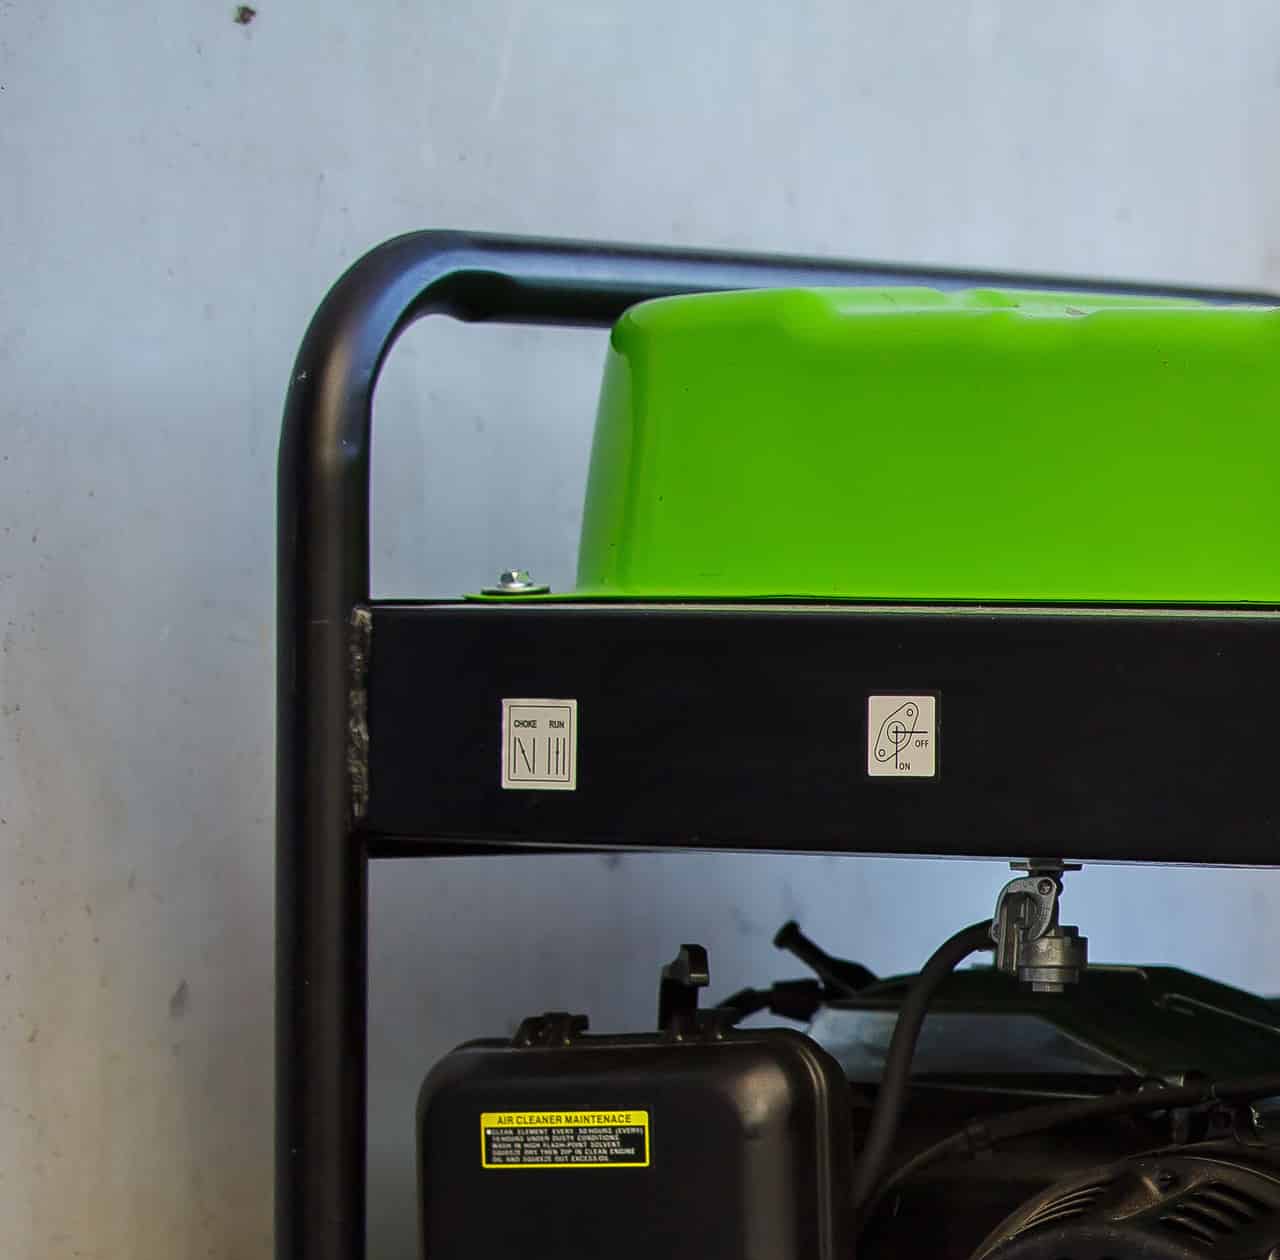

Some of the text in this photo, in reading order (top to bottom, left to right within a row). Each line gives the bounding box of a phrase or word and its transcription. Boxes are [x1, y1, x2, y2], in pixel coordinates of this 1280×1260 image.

[513, 719, 565, 728] CHOKE RUN
[915, 739, 929, 749] OFF
[899, 762, 911, 771] ON
[497, 1115, 514, 1125] AIR
[517, 1114, 562, 1125] CLEANER
